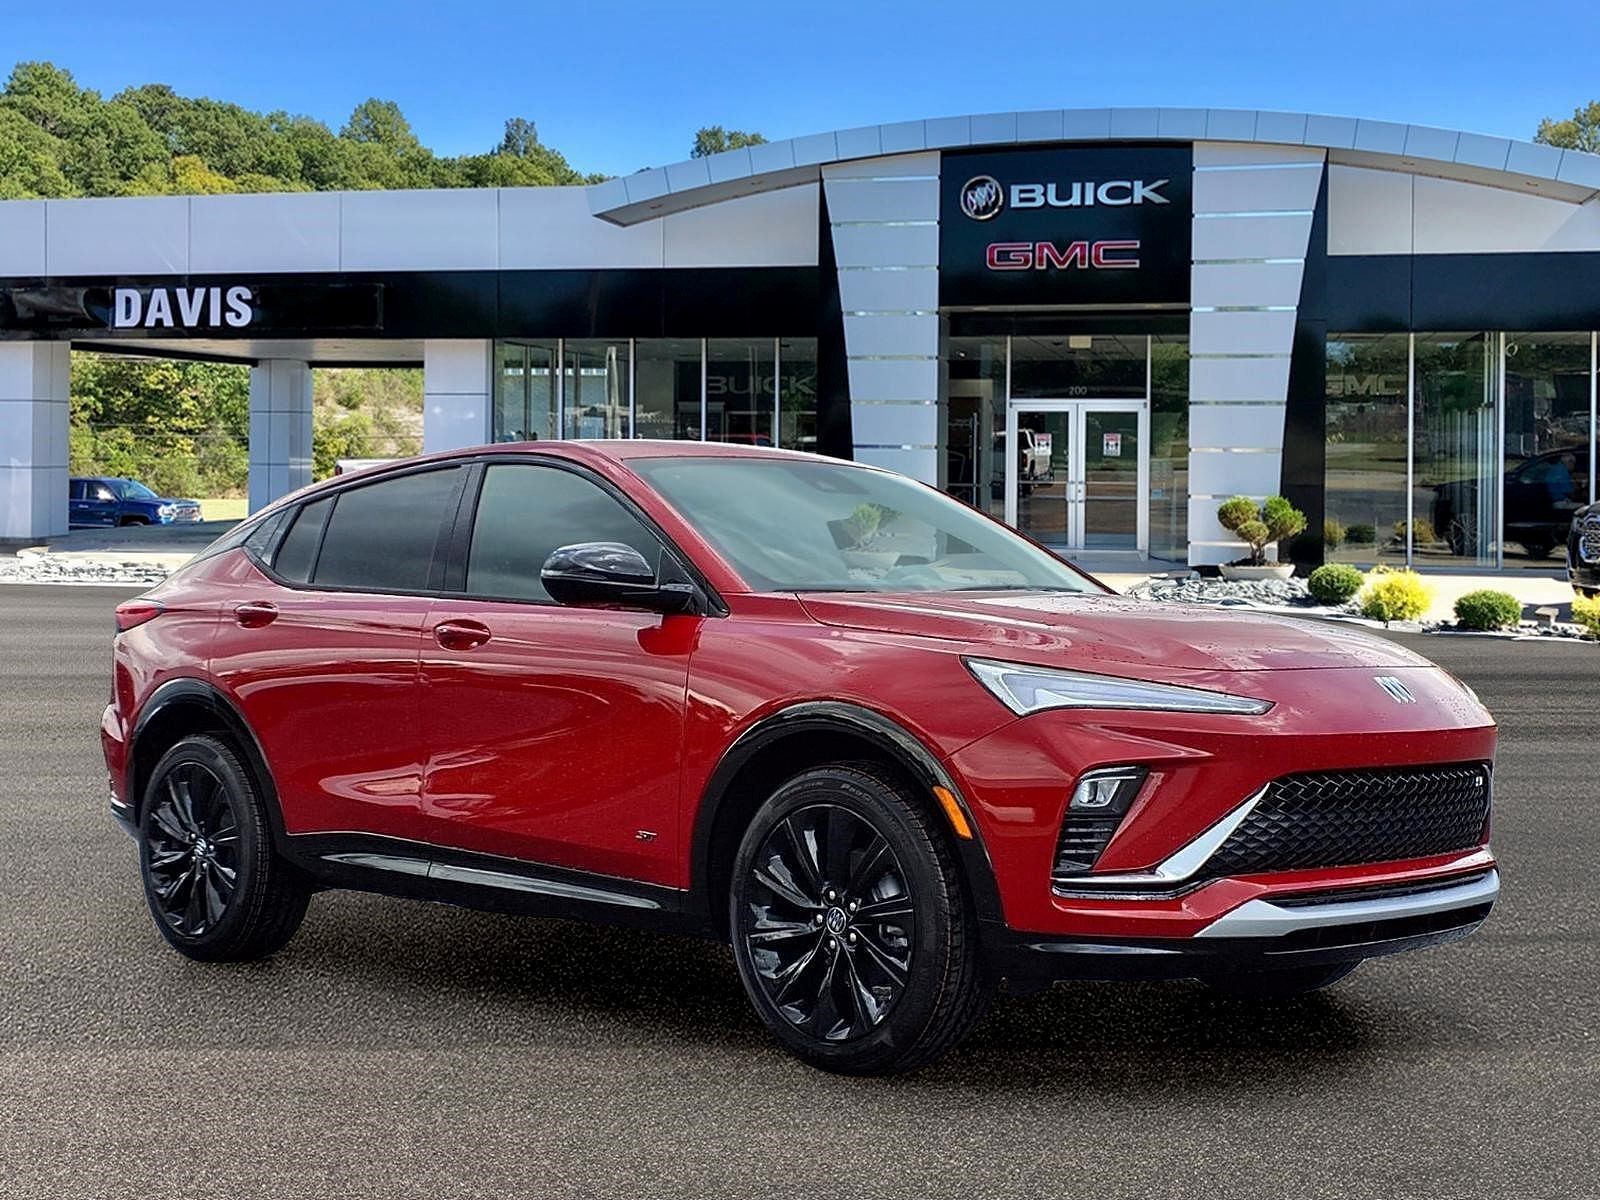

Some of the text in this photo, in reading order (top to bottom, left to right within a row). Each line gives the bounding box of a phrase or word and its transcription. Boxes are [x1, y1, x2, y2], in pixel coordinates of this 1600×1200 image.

[1010, 179, 1170, 208] BUICK
[986, 240, 1140, 270] GMC
[114, 286, 253, 328] DAVIS
[706, 375, 816, 394] BUICK
[1069, 385, 1088, 396] 200
